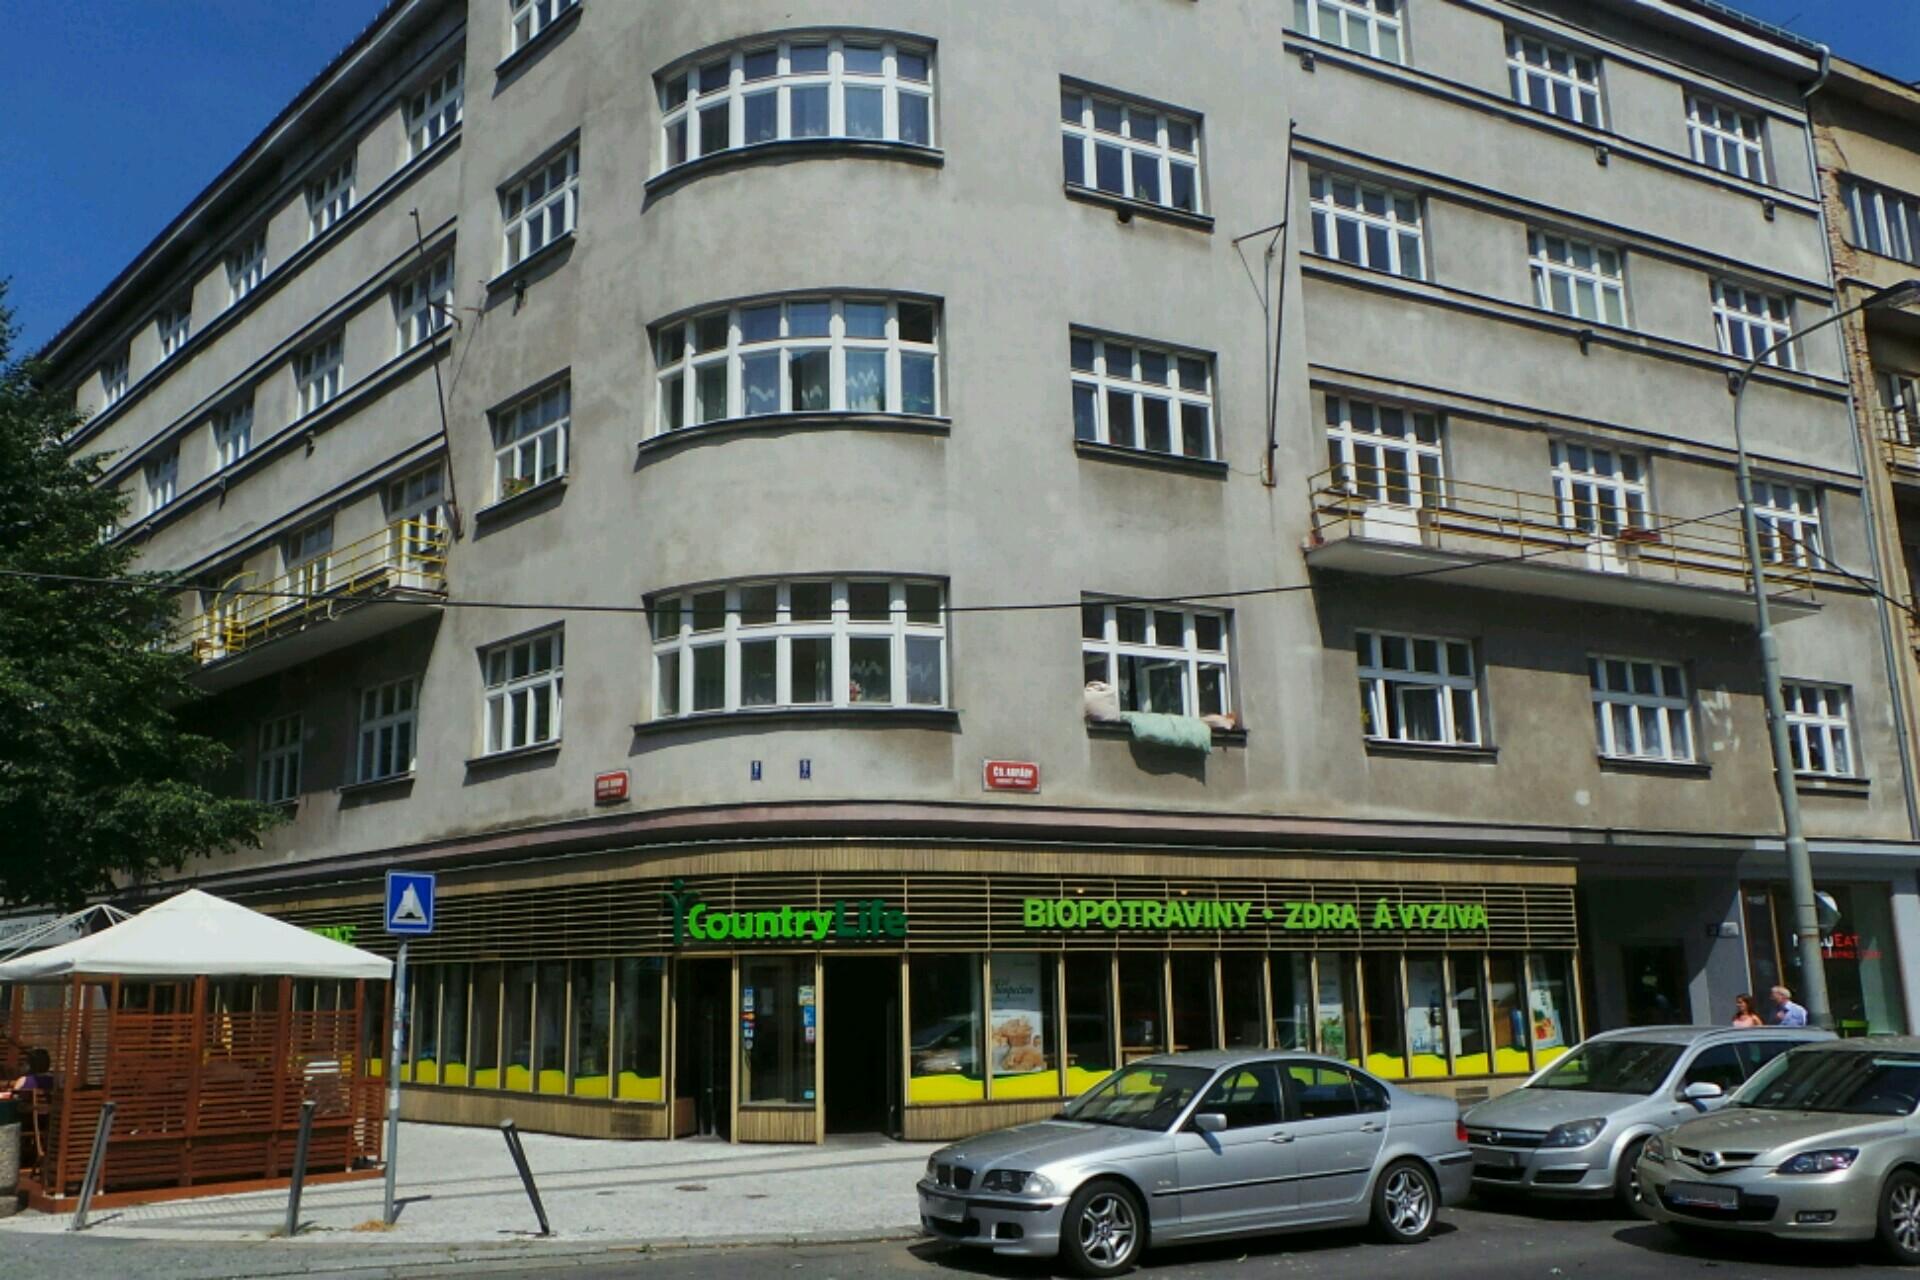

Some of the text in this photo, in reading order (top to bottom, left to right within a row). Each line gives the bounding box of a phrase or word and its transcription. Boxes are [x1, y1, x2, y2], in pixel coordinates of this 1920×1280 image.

[688, 900, 908, 940] Country Life
[1024, 899, 1252, 928] BIOPOTRAVINY
